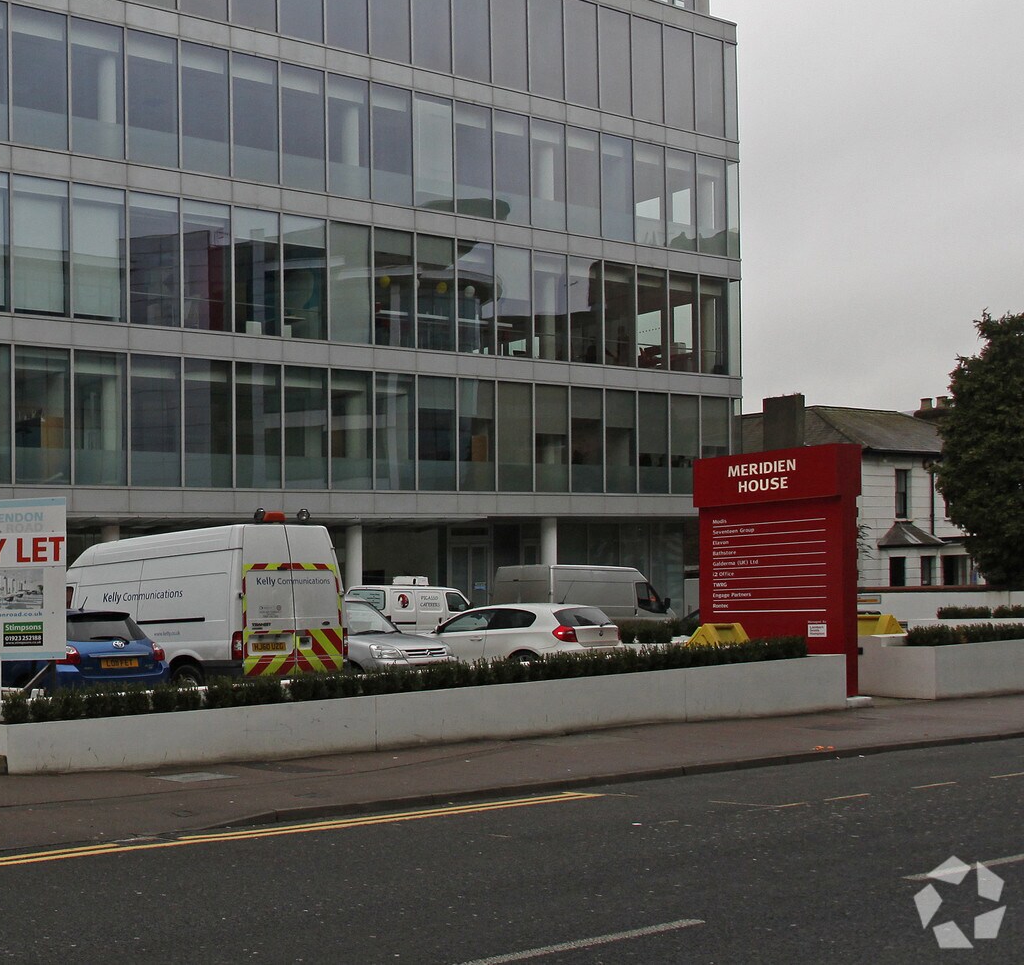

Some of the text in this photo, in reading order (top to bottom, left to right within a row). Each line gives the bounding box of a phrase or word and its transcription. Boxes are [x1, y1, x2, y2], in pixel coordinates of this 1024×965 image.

[728, 459, 796, 477] MERIDIEN
[738, 477, 788, 493] HOUSE
[5, 522, 44, 534] ROAD
[16, 536, 65, 562] LET
[256, 576, 330, 587] Kelly Communications
[102, 588, 183, 604] Kelly Communications
[5, 624, 41, 632] Stimpsons
